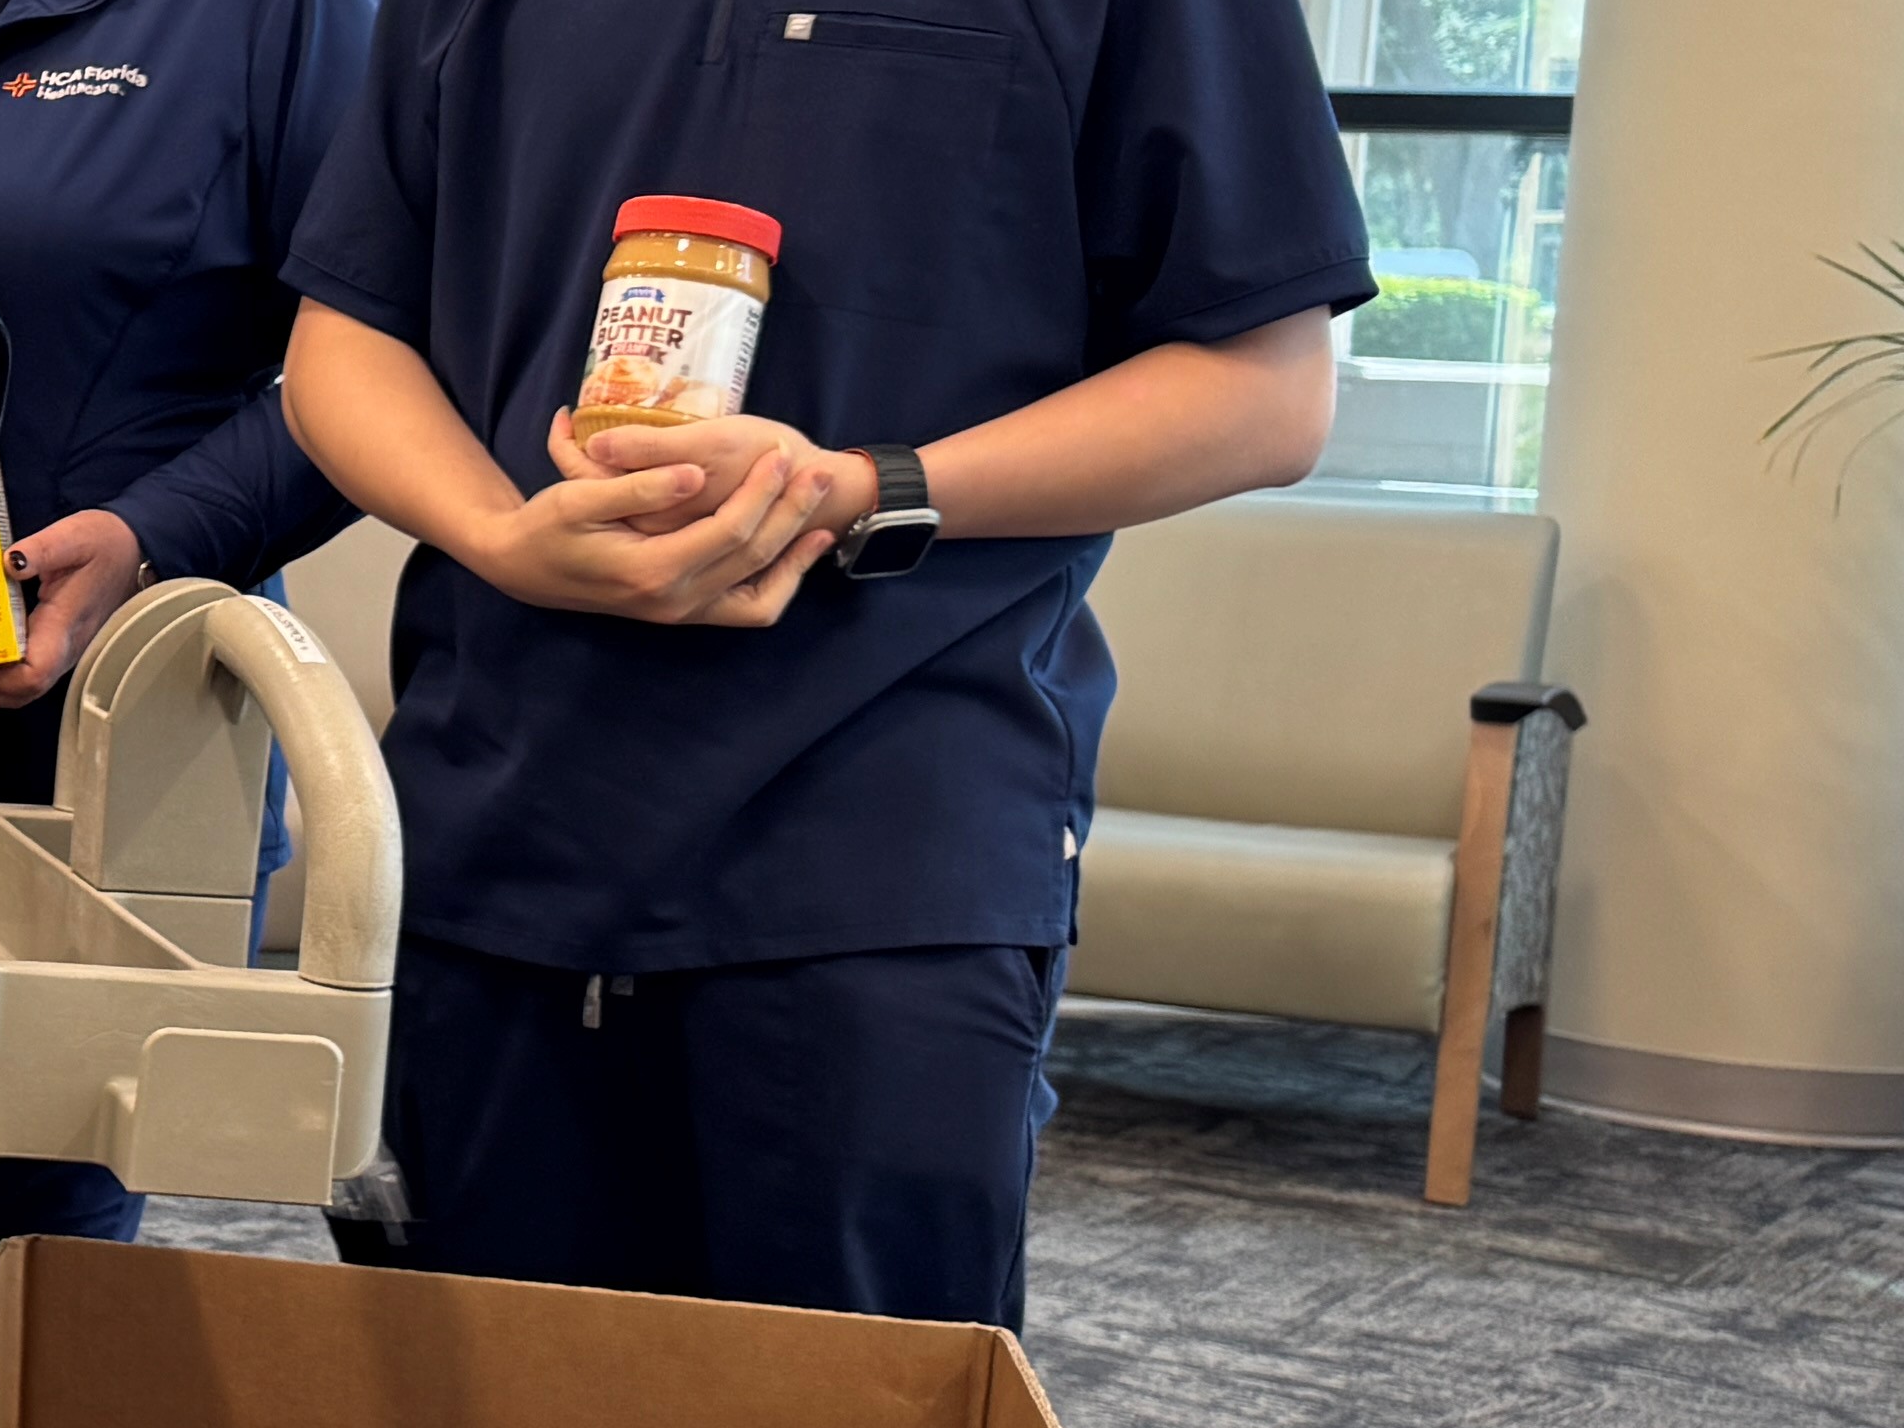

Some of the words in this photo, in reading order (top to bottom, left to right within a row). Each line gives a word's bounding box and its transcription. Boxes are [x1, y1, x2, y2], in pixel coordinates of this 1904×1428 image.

[40, 69, 82, 86] HCA
[84, 64, 148, 87] Florida
[599, 306, 692, 329] PEANUT
[596, 324, 685, 349] BUTTER
